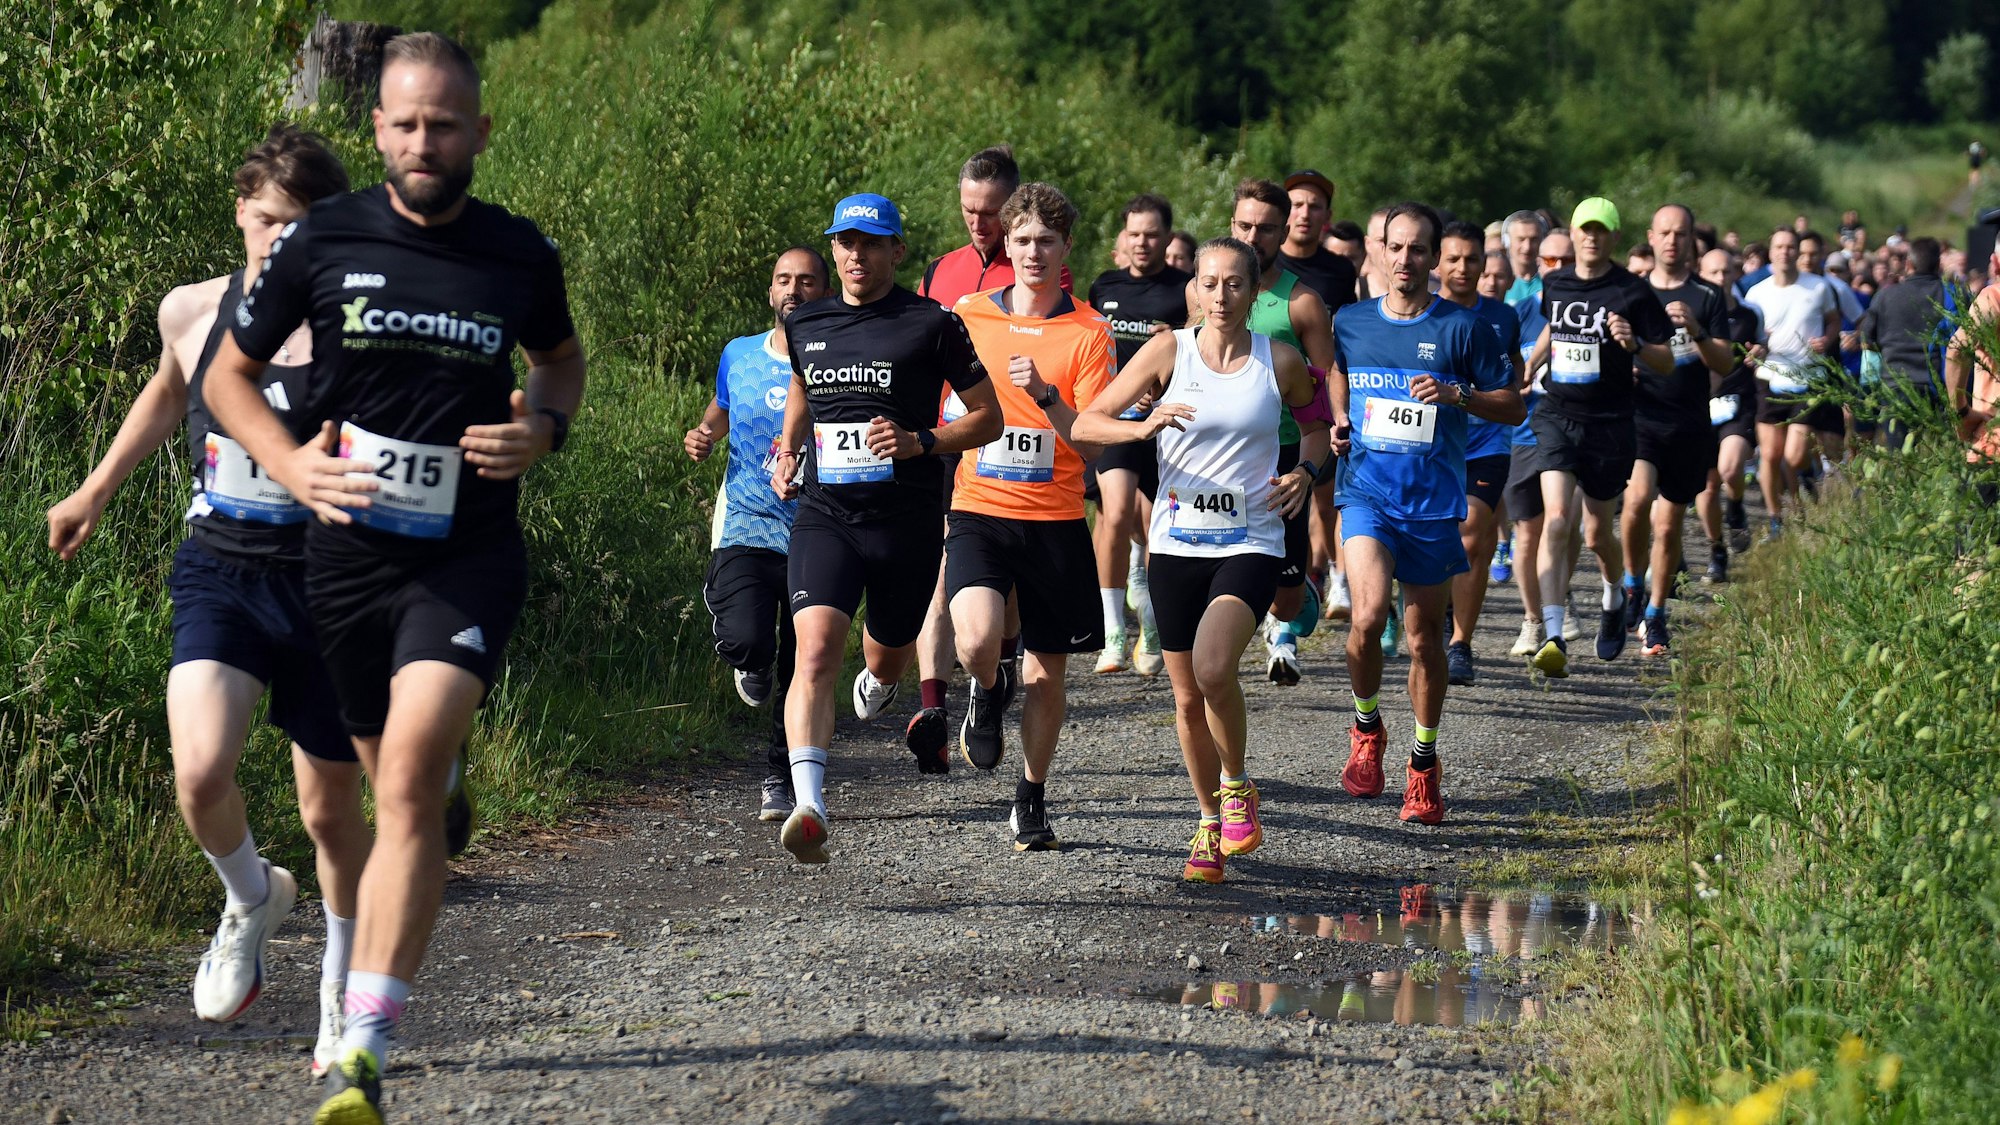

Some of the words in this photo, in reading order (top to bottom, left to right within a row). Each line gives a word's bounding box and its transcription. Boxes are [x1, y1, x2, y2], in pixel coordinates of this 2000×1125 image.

[841, 205, 879, 220] HOKA
[1550, 301, 1589, 329] LG
[341, 296, 503, 355] Xcoating
[1009, 323, 1043, 336] hummel
[805, 342, 827, 352] JAKO
[1418, 342, 1437, 350] PFERD
[1565, 349, 1592, 362] 430
[1388, 407, 1423, 427] 461
[837, 430, 868, 450] 21
[1006, 432, 1042, 453] 161
[376, 448, 443, 487] 215
[1012, 457, 1035, 465] Lasse
[1193, 493, 1235, 513] 440
